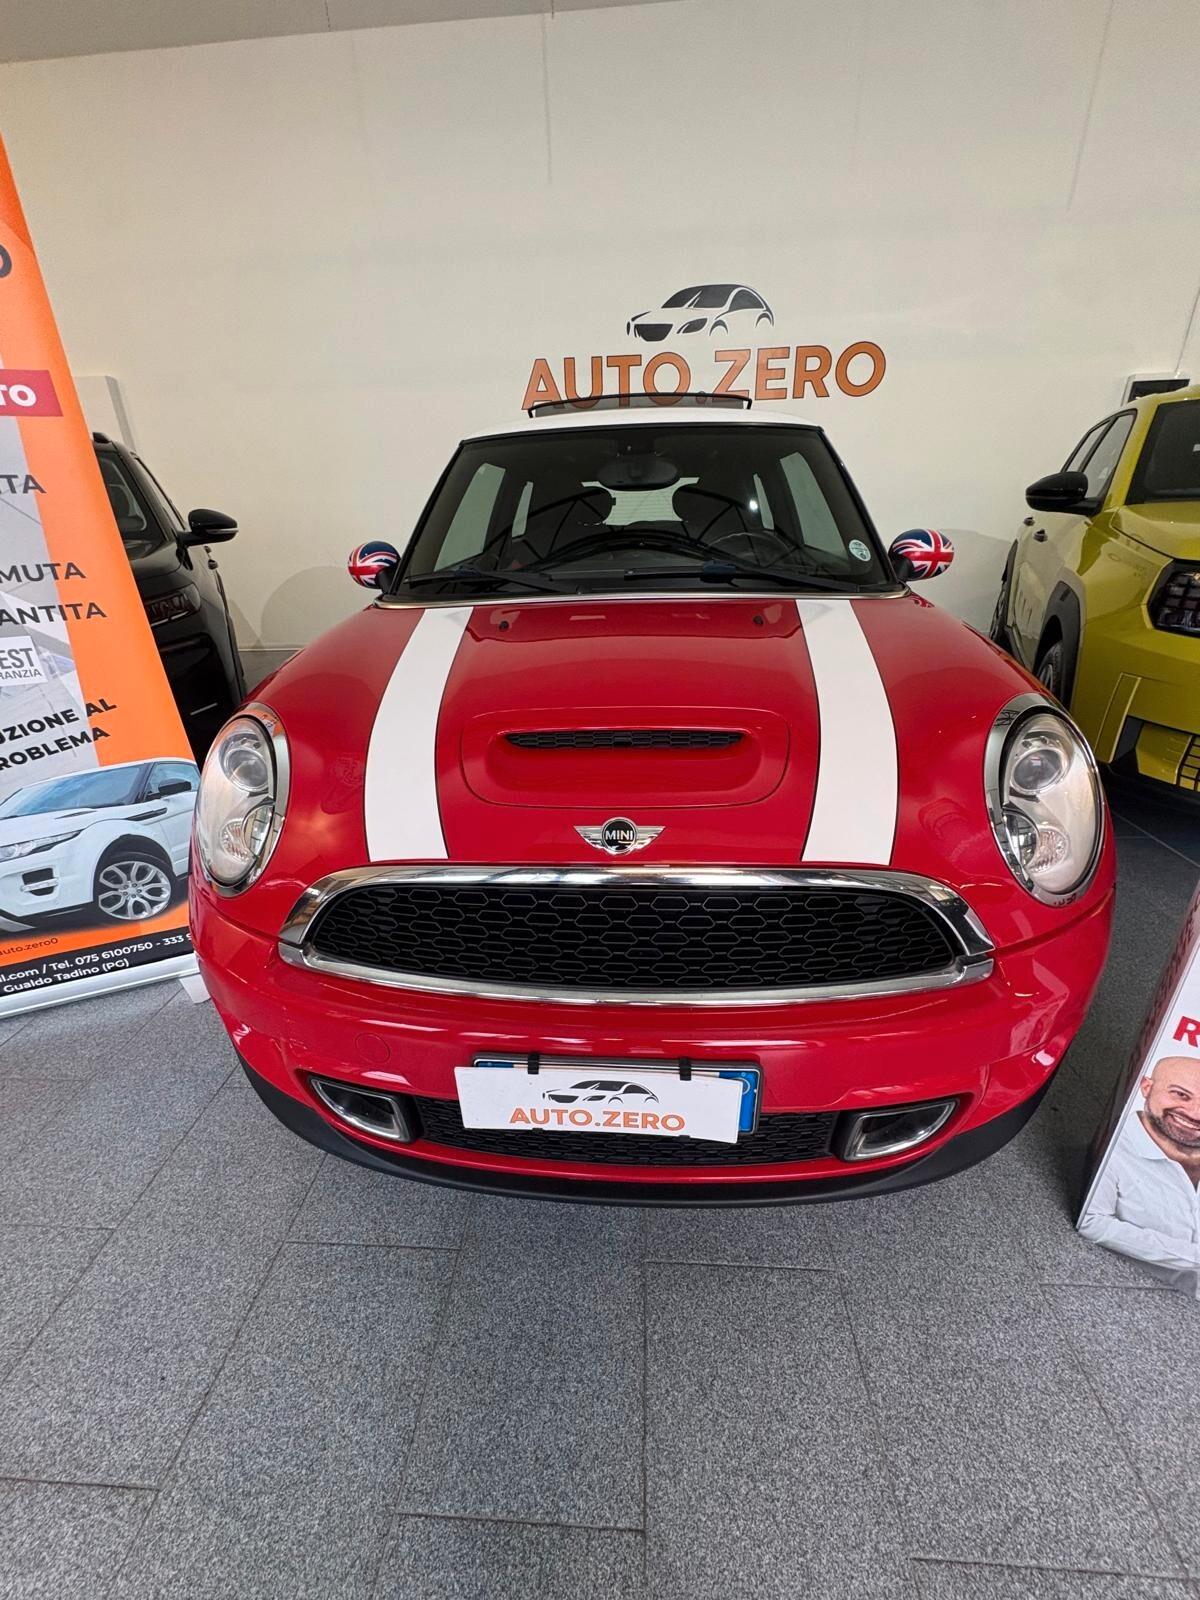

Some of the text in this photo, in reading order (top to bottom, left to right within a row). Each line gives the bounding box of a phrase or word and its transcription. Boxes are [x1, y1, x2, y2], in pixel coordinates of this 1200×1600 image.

[521, 341, 886, 411] AUTO.ZERO
[85, 698, 117, 717] AL
[605, 830, 633, 840] MINI
[48, 960, 73, 971] Tel.
[75, 954, 99, 966] 075
[101, 942, 153, 959] 6100750
[162, 934, 185, 946] 333
[3, 958, 129, 993] Gualdo Tadino (PG)
[509, 1107, 686, 1132] AUTO.ZERO
